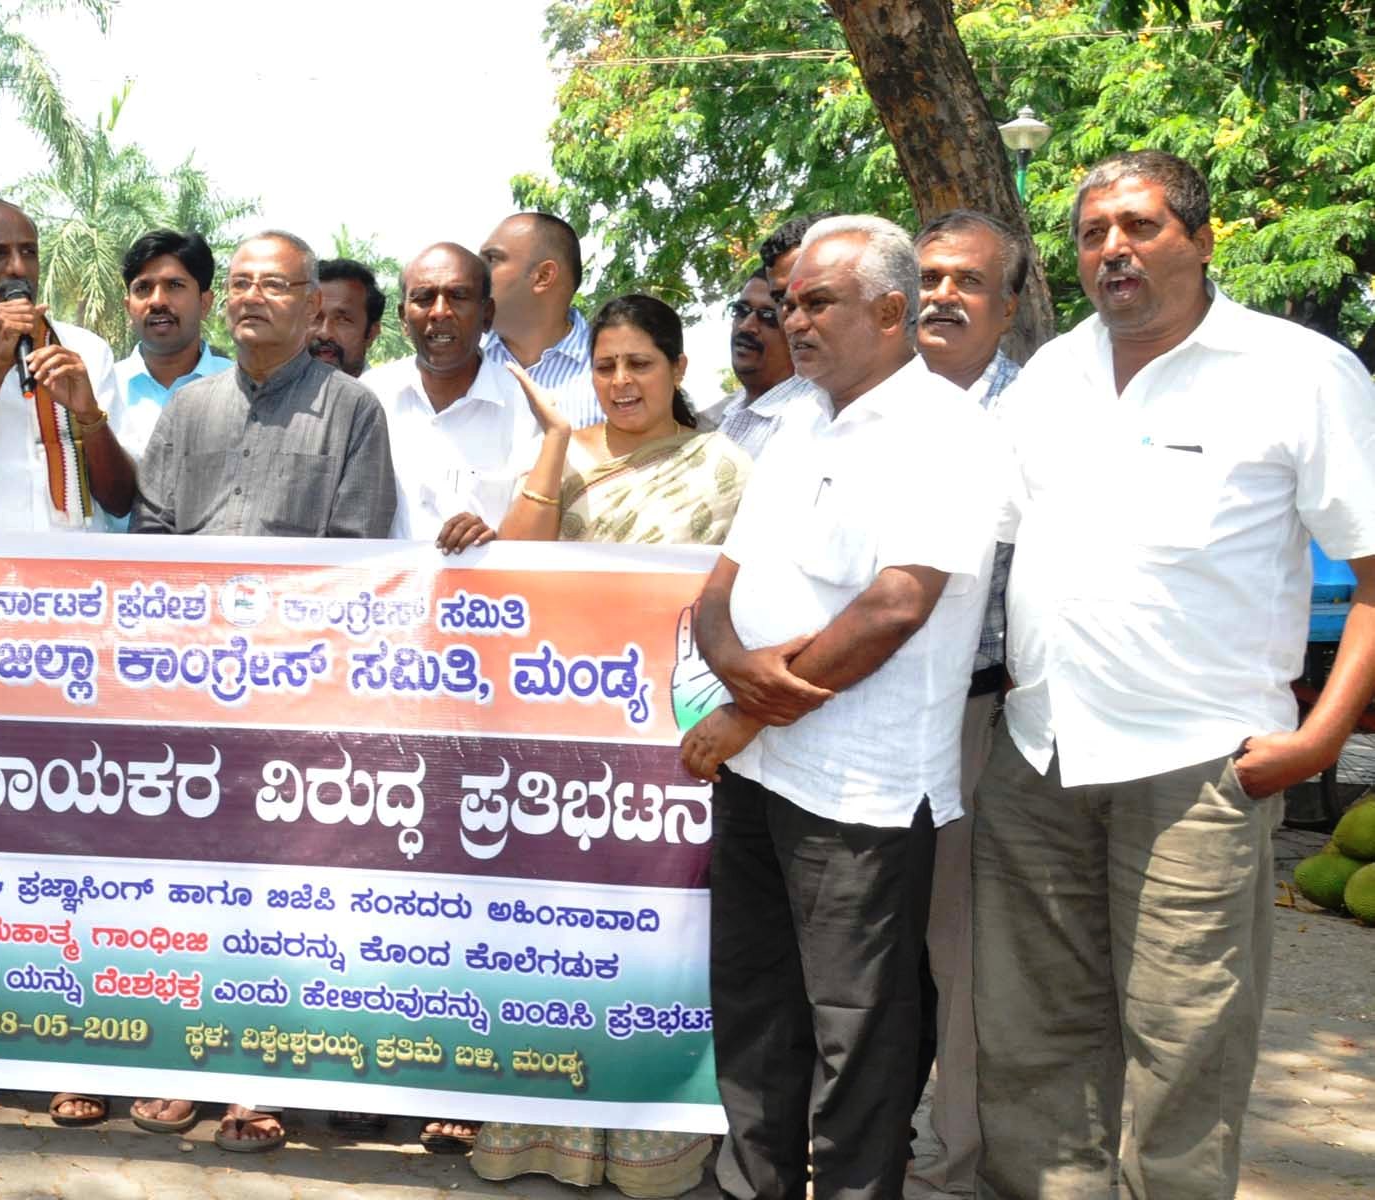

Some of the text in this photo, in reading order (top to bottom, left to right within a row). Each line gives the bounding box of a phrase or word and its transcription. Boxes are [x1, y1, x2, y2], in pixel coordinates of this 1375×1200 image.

[117, 586, 207, 629] ಪ್ರದೇಶ
[440, 594, 526, 629] ಸಮಿತಿ
[117, 636, 328, 702] ಕಾಂಗ್ರೇಸ್
[351, 640, 490, 700] ಸಮಿತಿ,
[514, 645, 651, 725] ಮಂಡ್ಯ
[255, 741, 426, 860] ವಿರುದ್ಧ
[17, 871, 155, 914] ಪ್ರಜ್ಞಾಸಿಂಗ್
[168, 880, 253, 907] ಹಾಗೂ
[266, 883, 336, 911] ಬಿಜೆಪಿ
[350, 887, 473, 919] ಸಂಸದರು
[487, 899, 661, 932] ಅಹಿಂಸಾವಾದಿ
[91, 926, 209, 954] ಗಾಂಧೀಜಿ
[222, 928, 346, 973] ಯವರನ್ನು
[359, 935, 451, 967] ಕೊಂದ
[464, 942, 620, 980] ಕೊಲೆಗಡುಕ
[6, 964, 83, 1004] ಯನ್ನು
[94, 967, 201, 1008] ದೇಶಭಕ್ತ
[214, 978, 289, 1005] ಎಂದು
[302, 979, 488, 1033] ಹೇಳಿರುವುದನ್ನು
[500, 1000, 595, 1029] ಖಂಡಿಸಿ
[185, 1023, 230, 1060] ಸ್ಥಳ:
[240, 1025, 365, 1070] ವಿಶ್ವೇಶ್ವರಯ್ಯ
[375, 1035, 443, 1069] ಪ್ರತಿಮೆ
[454, 1045, 500, 1072] ಬಳಿ,
[511, 1048, 586, 1087] ಮಂಡ್ಯ
